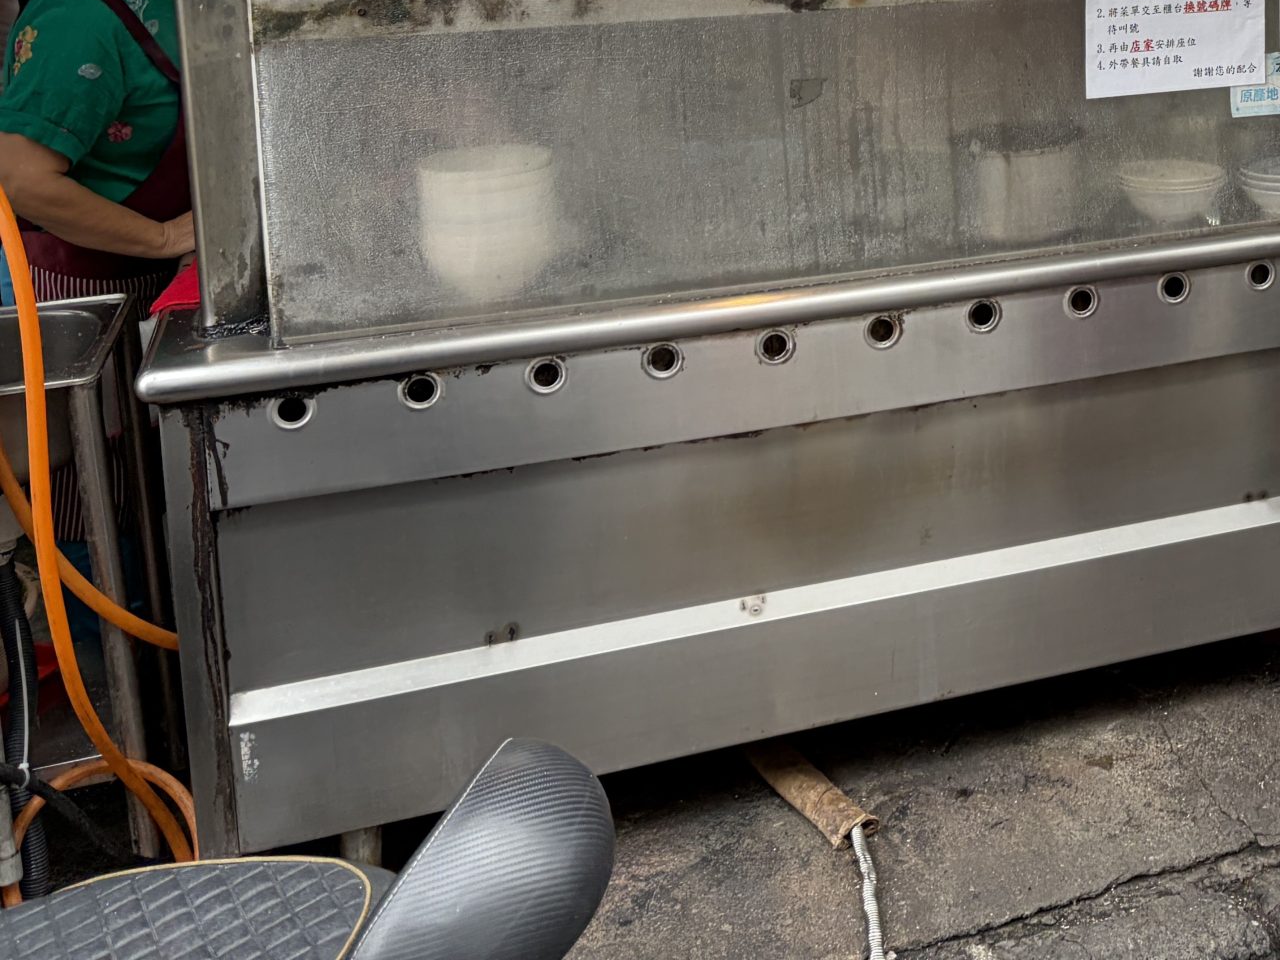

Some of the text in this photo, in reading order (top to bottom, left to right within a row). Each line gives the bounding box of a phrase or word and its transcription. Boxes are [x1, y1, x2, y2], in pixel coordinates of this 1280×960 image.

[1193, 62, 1257, 78] 謝謝您的配合
[1240, 86, 1279, 103] 原產地
